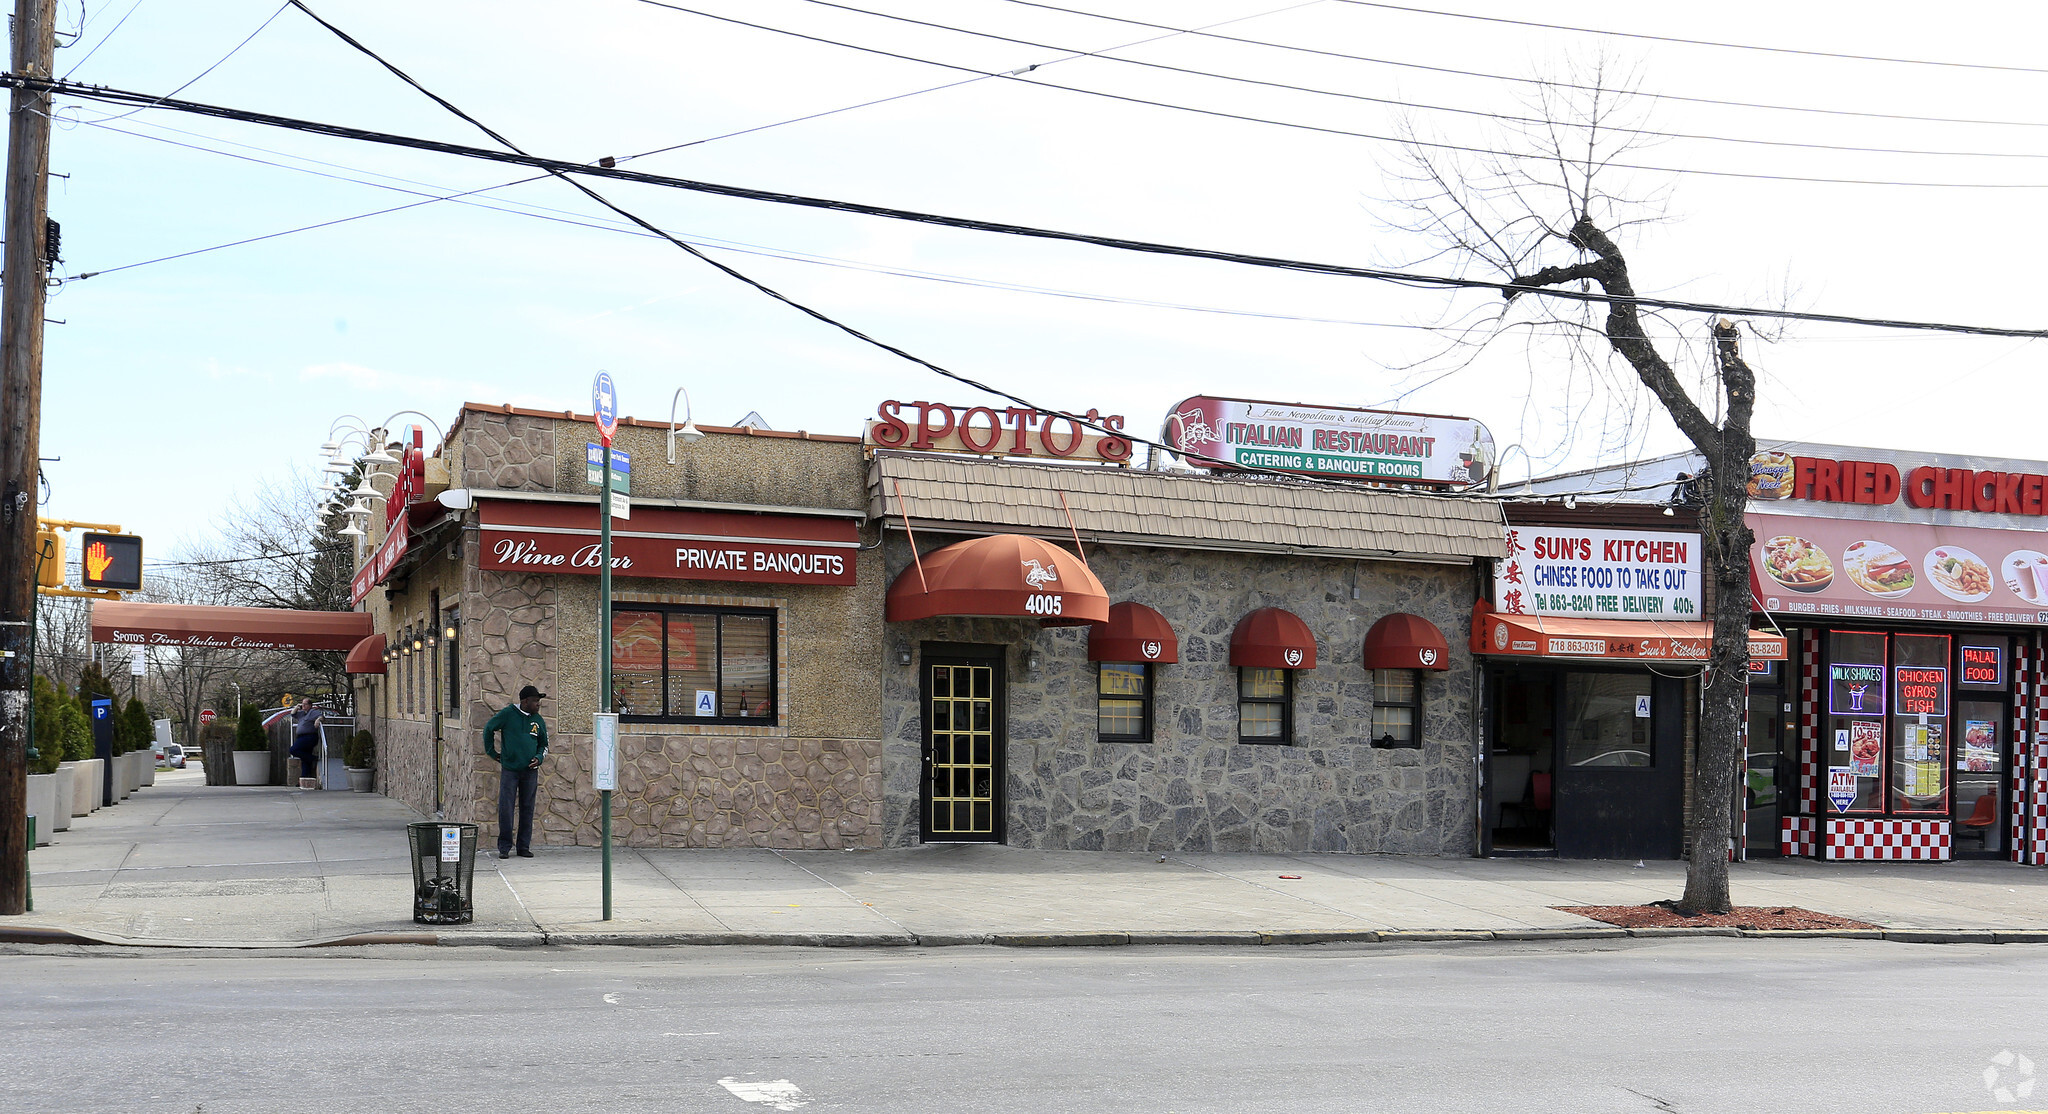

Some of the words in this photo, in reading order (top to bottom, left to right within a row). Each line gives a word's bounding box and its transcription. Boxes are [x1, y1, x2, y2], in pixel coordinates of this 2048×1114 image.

[1259, 408, 1284, 417] Fine
[872, 400, 1132, 460] SPOTO'S
[1226, 422, 1302, 449] ITALIAN
[1312, 429, 1435, 458] RESTAURANT
[1241, 452, 1301, 468] CATERING
[1305, 457, 1314, 469] &
[1318, 457, 1375, 473] BANQUET
[1378, 462, 1420, 476] ROOMS
[1756, 478, 1781, 490] Neck
[1792, 456, 1900, 505] FRIED
[1907, 466, 2048, 515] CHICKE
[494, 539, 565, 567] Wine
[570, 543, 633, 569] Bar
[1534, 536, 1591, 561] SUN'S
[1604, 539, 1687, 564] KITCHEN
[676, 548, 748, 571] PRIVATE
[753, 551, 844, 576] BANQUETS
[1534, 564, 1577, 587] CHINESE
[1582, 566, 1612, 588] FOOD
[1616, 567, 1631, 588] TO
[1635, 569, 1660, 590] TAKE
[1664, 568, 1687, 590] OUT
[1025, 594, 1062, 615] 4005
[1535, 593, 1547, 610] Tel
[1550, 594, 1593, 612] 863-8240
[1596, 595, 1618, 612] FREE
[1623, 596, 1664, 613] DELIVERY
[1788, 602, 1816, 612] BURGER
[1821, 604, 1839, 613] FRIES
[1844, 605, 1881, 615] MILKSHAKE
[1887, 607, 1916, 617] SEAFOOD
[1921, 609, 1941, 619] STEAK
[1947, 610, 1983, 620] SMOOTHIES
[1988, 612, 2004, 622] FREE
[2005, 613, 2034, 623] DELIVERY
[150, 632, 180, 645] Fine
[182, 635, 228, 647] Italian
[231, 635, 274, 649] Cuisine
[1550, 641, 1564, 651] 718
[1567, 641, 1604, 652] 863-0316
[1639, 640, 1666, 656] Sun's
[1670, 641, 1707, 657] Kitchen
[1964, 649, 1997, 664] HALAL
[1832, 667, 1850, 680] MILK
[1850, 667, 1881, 681] SHAKES
[1897, 670, 1943, 683] CHICKEN
[1966, 667, 1995, 681] FOOD
[1904, 685, 1937, 698] GYROS
[699, 694, 712, 710] A
[1638, 698, 1648, 711] A
[1906, 699, 1935, 712] FISH
[98, 708, 105, 718] P
[1837, 732, 1847, 745] A
[1831, 773, 1855, 785] ATM
